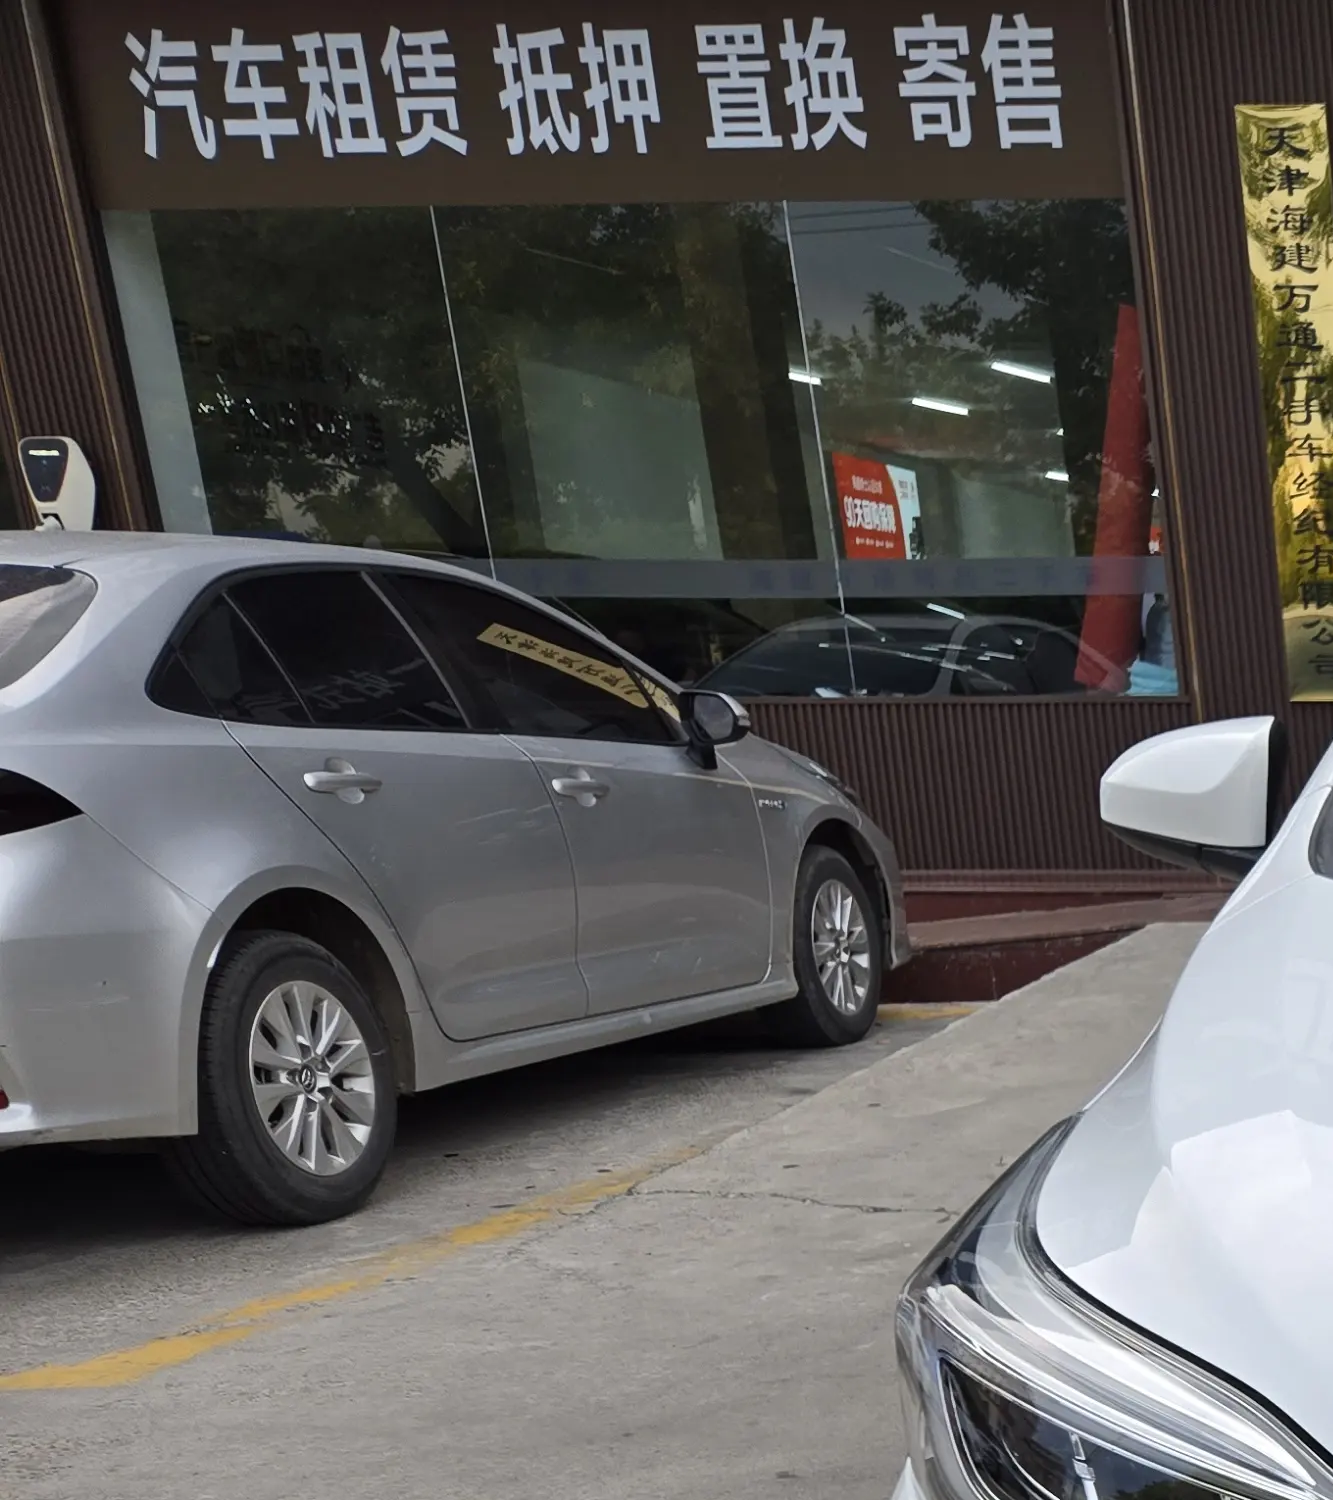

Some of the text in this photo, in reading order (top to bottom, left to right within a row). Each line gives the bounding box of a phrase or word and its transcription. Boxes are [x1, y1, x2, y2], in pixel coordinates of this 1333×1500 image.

[124, 13, 1063, 160] 汽车租赁 抵押 置换 寄售
